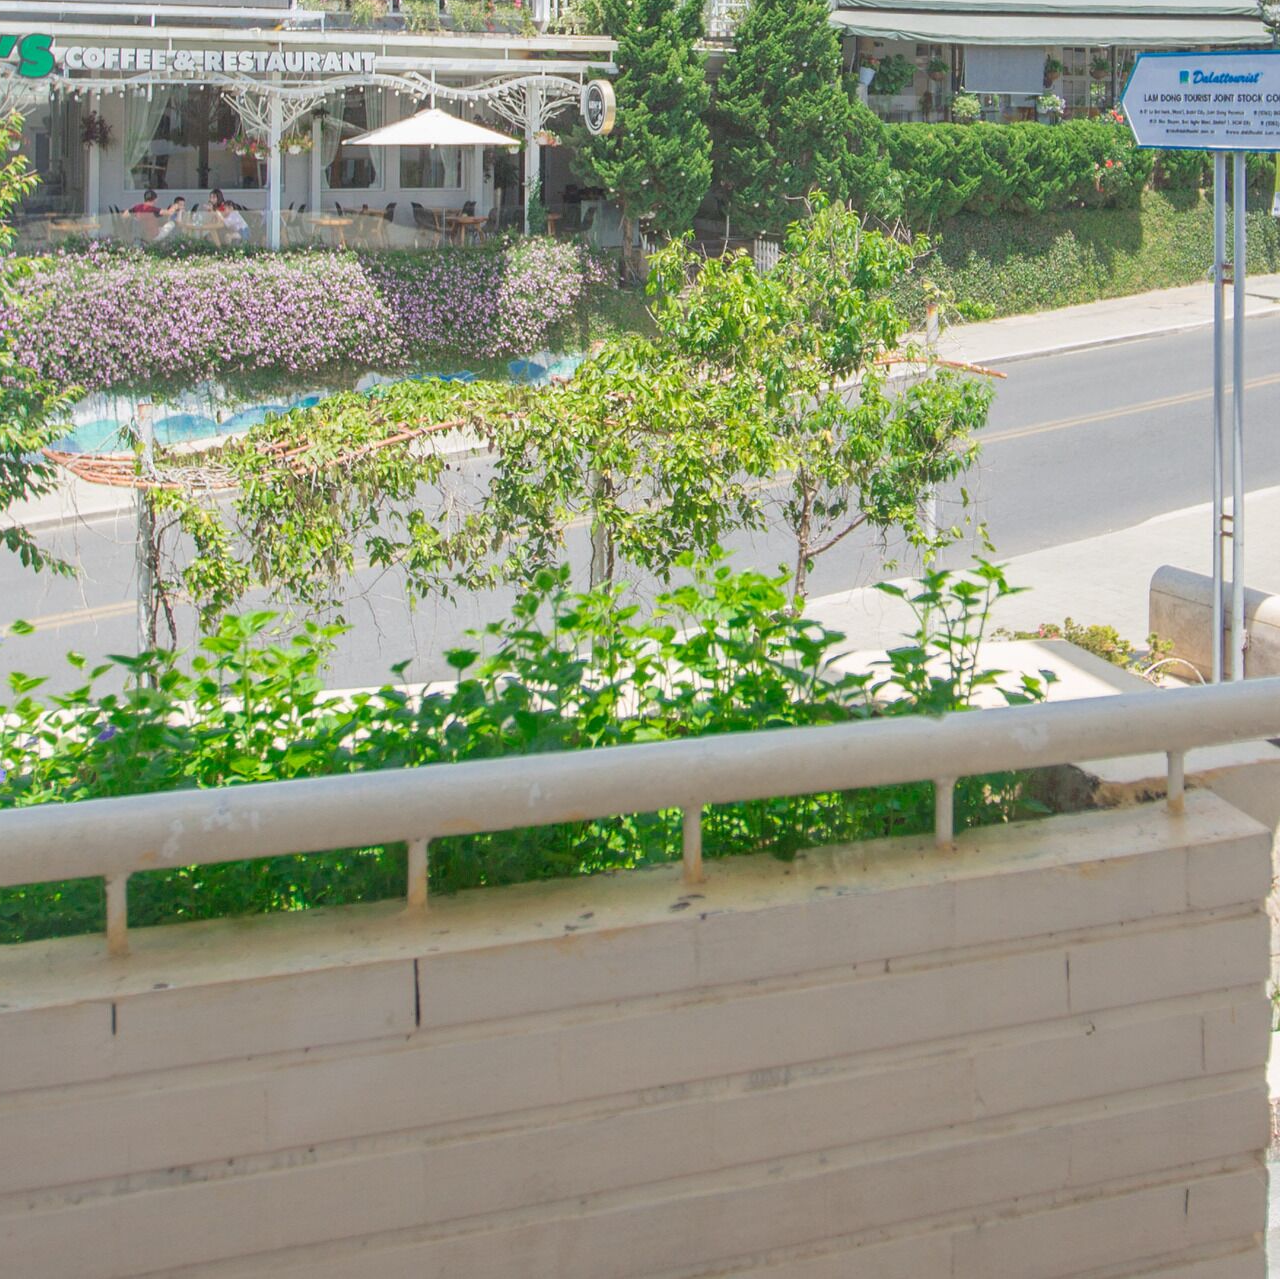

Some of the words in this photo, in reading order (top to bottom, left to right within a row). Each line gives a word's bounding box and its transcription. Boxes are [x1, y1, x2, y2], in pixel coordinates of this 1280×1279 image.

[65, 46, 168, 70] COFFEE
[173, 49, 197, 71] &
[204, 51, 376, 72] RESTAURANT
[1192, 70, 1260, 84] Dalattourist
[1143, 93, 1159, 102] LAM
[1160, 94, 1182, 103] DONG
[1184, 94, 1211, 103] TOURIST
[1213, 94, 1234, 103] JOINT
[1237, 93, 1263, 103] STOCK
